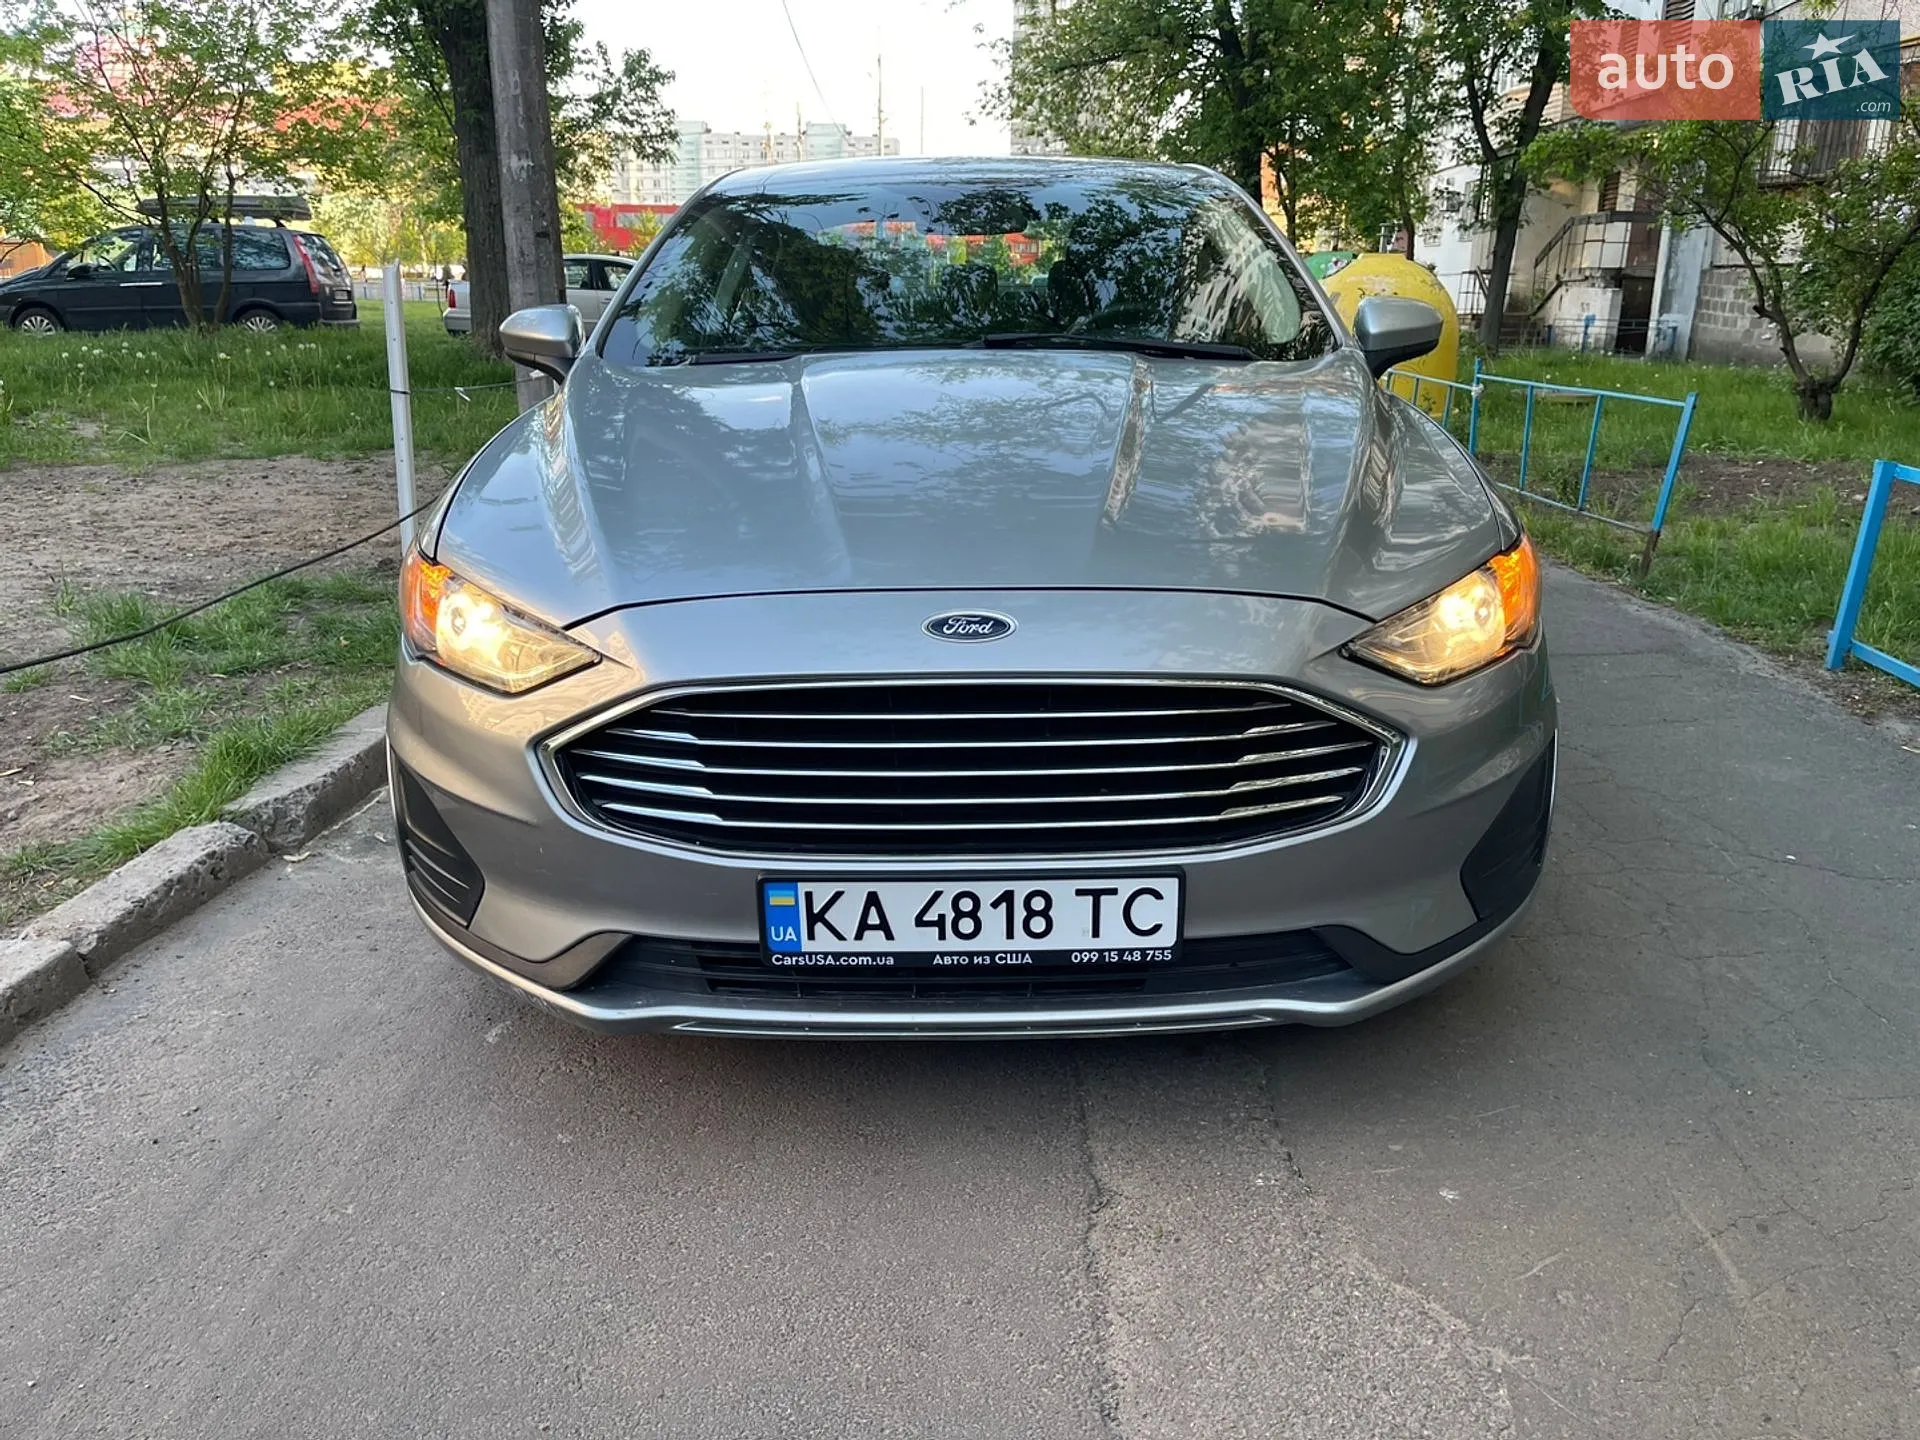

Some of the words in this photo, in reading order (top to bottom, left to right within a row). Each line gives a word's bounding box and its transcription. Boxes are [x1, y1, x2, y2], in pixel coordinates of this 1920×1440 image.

[942, 616, 994, 635] Ford
[804, 890, 895, 941] KA
[914, 889, 1054, 941] 4818
[1074, 886, 1164, 938] TC
[771, 926, 798, 942] UA
[771, 954, 895, 966] CarsUSA.com.ua
[995, 952, 1033, 964] США
[1071, 951, 1099, 963] 099
[1102, 950, 1119, 962] 15
[1122, 949, 1141, 962] 48
[1145, 949, 1172, 961] 755
